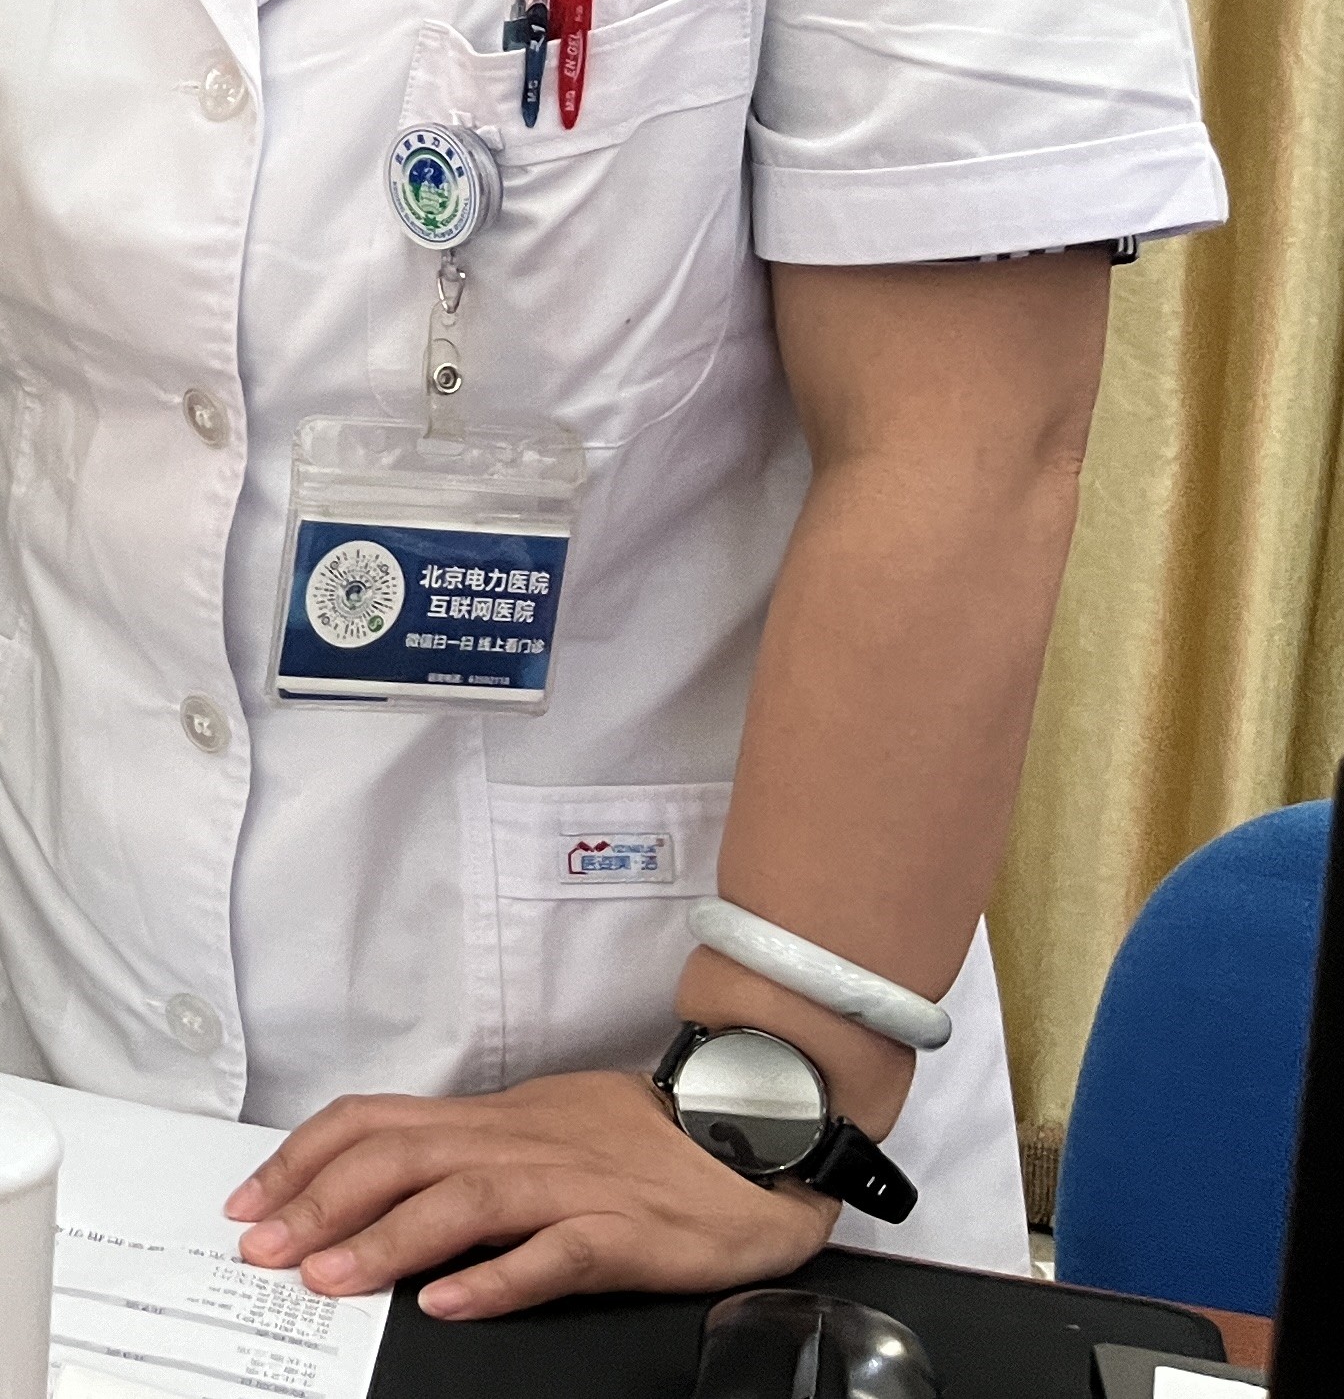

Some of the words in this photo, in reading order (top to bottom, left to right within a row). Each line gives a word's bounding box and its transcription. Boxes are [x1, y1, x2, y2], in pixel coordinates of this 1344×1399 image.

[419, 564, 551, 595] 北京电力医院
[427, 595, 536, 623] 互联网医院
